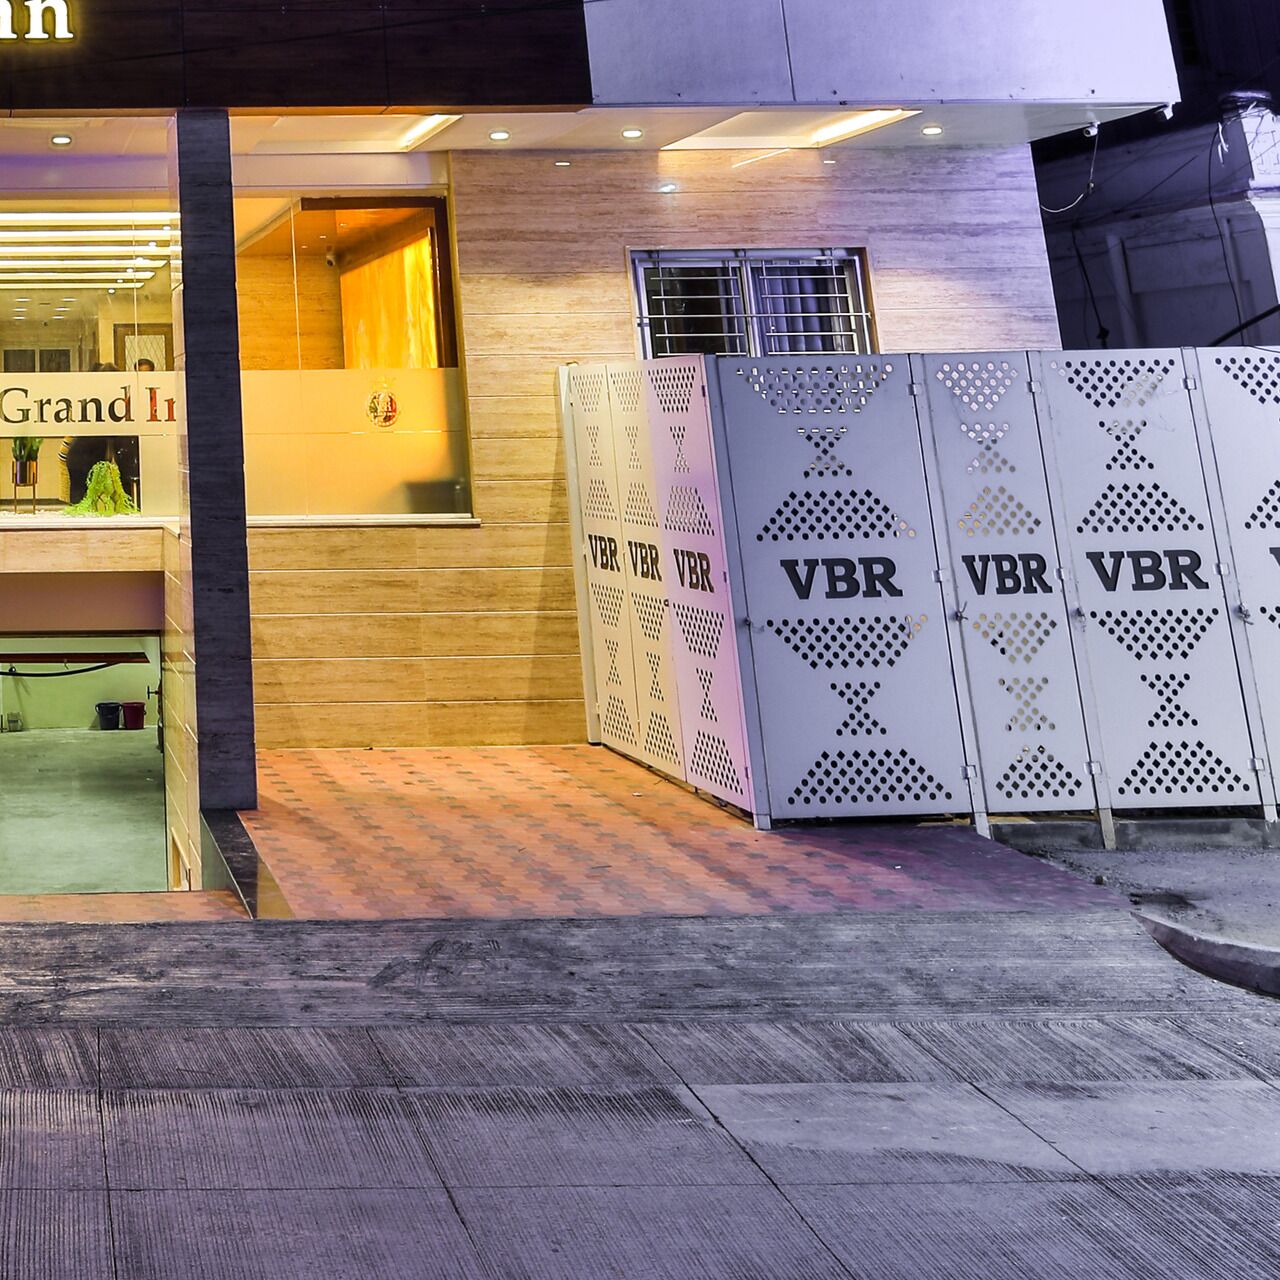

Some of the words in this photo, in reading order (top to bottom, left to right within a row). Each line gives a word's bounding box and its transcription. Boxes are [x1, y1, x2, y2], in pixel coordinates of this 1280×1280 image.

[587, 533, 621, 573] VBR
[627, 540, 663, 582] VBR
[672, 547, 715, 594] VBR
[961, 553, 1053, 596] VBR
[1085, 549, 1210, 593] VBR
[779, 556, 904, 601] VBR
